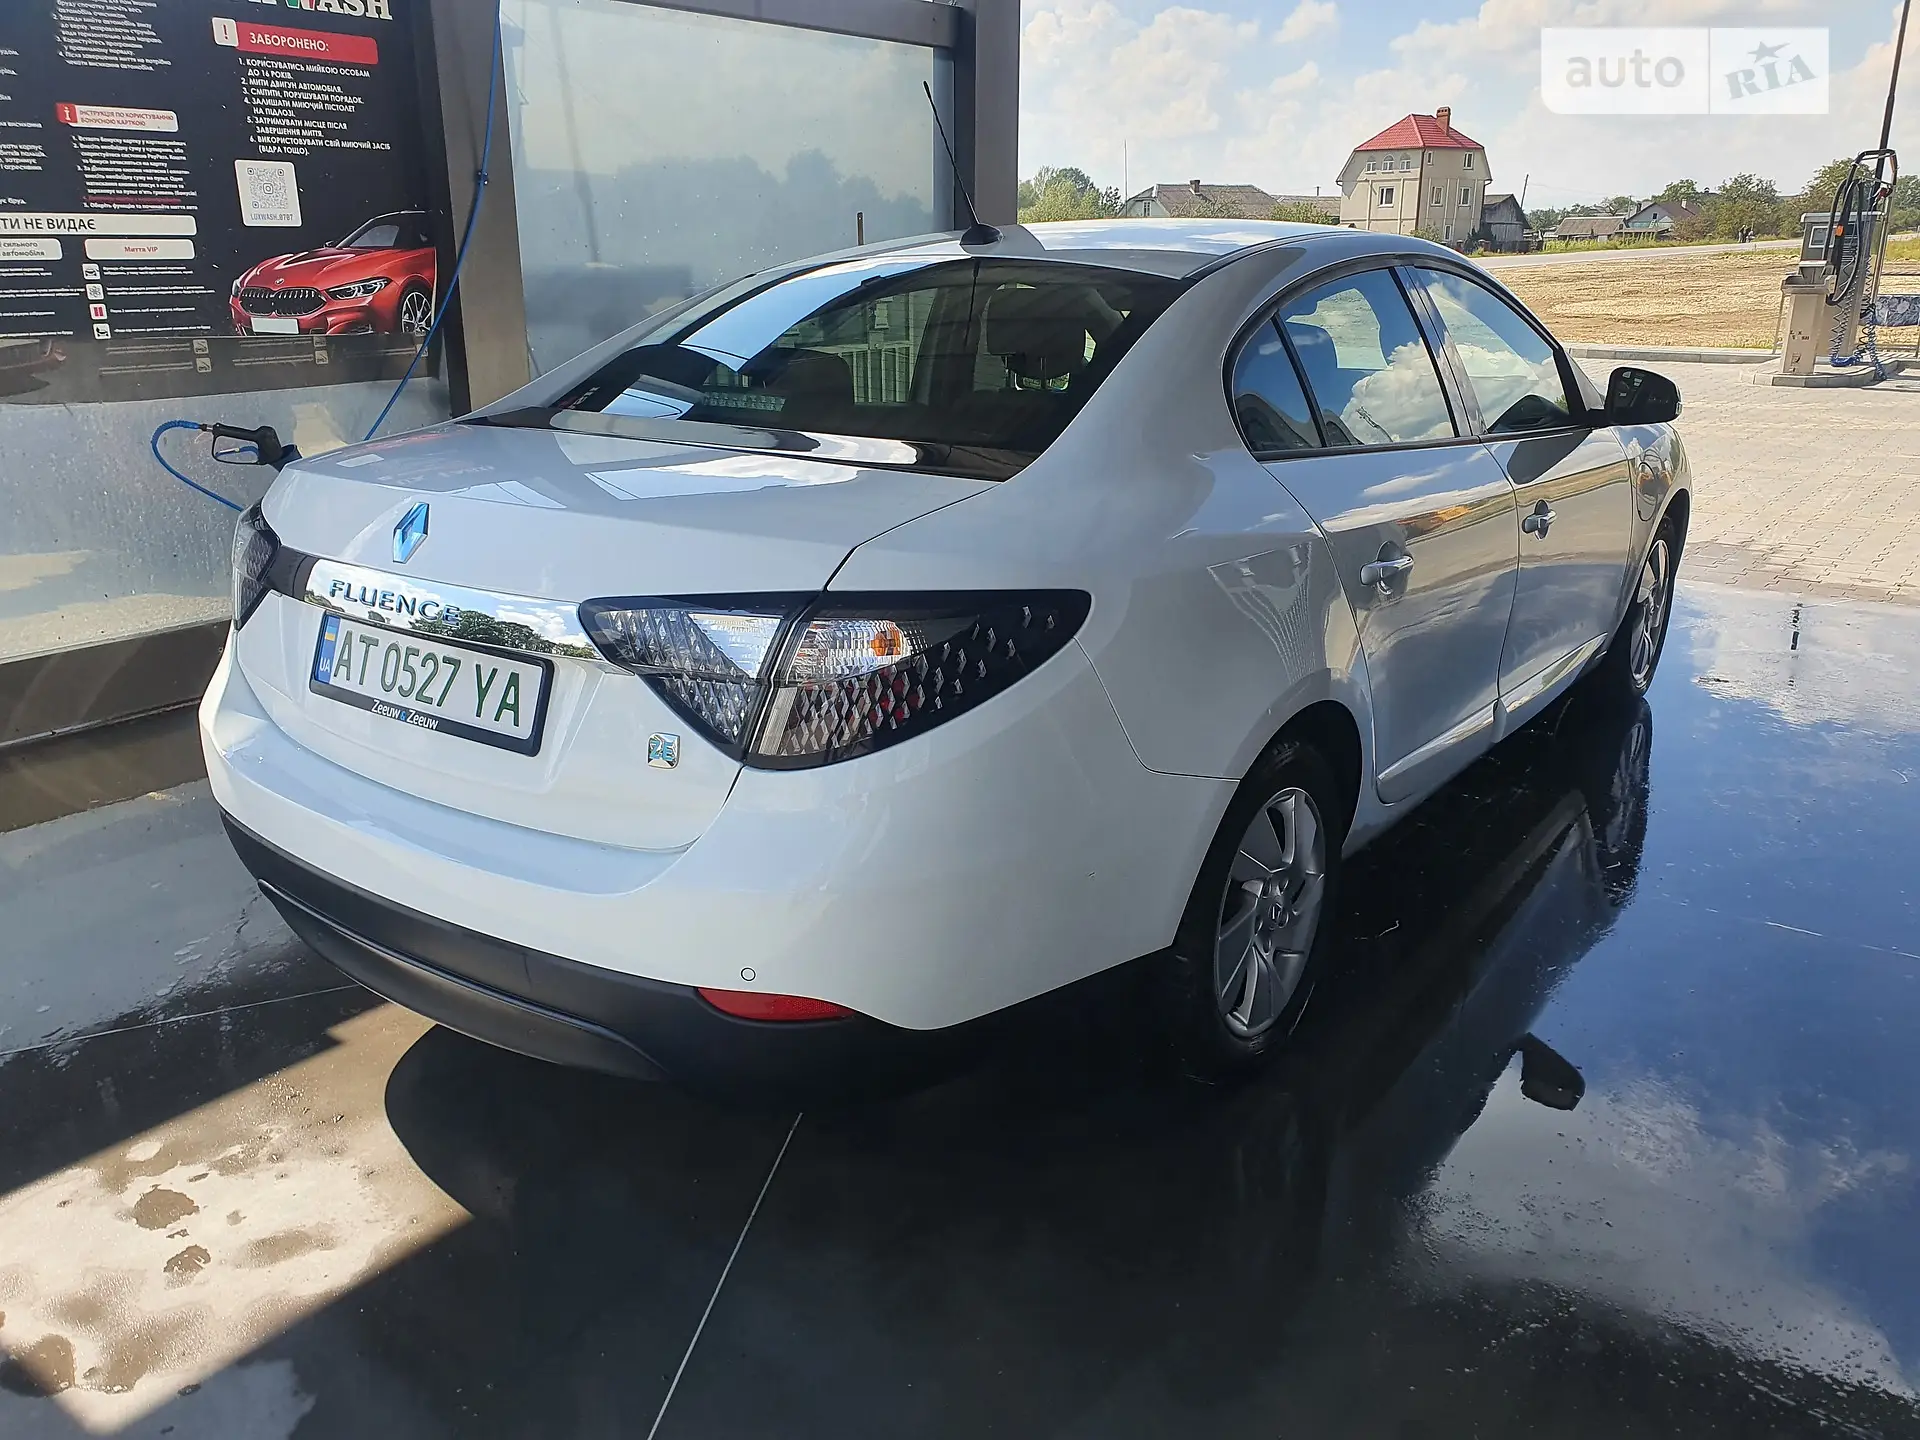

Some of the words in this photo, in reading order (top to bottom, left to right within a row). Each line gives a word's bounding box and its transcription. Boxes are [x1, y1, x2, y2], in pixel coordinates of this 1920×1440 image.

[249, 32, 329, 52] ЗАБОРОНЕНО:
[246, 59, 304, 71] КОРИСТУВАТИСЬ
[306, 65, 338, 75] МИЙКОЮ
[340, 69, 370, 78] ОСОБАМ
[248, 68, 259, 76] ДО
[250, 79, 269, 87] МИТИ
[270, 81, 297, 90] ДВИГУН
[24, 218, 44, 230] НЕ
[47, 218, 96, 232] ВИДАЄ
[329, 578, 462, 625] FLUENCE
[319, 660, 331, 673] UA
[334, 630, 380, 686] AT
[380, 642, 462, 707] 0527
[475, 663, 521, 728] YA
[371, 699, 400, 720] Zeeuw
[406, 710, 439, 730] Zeeuw
